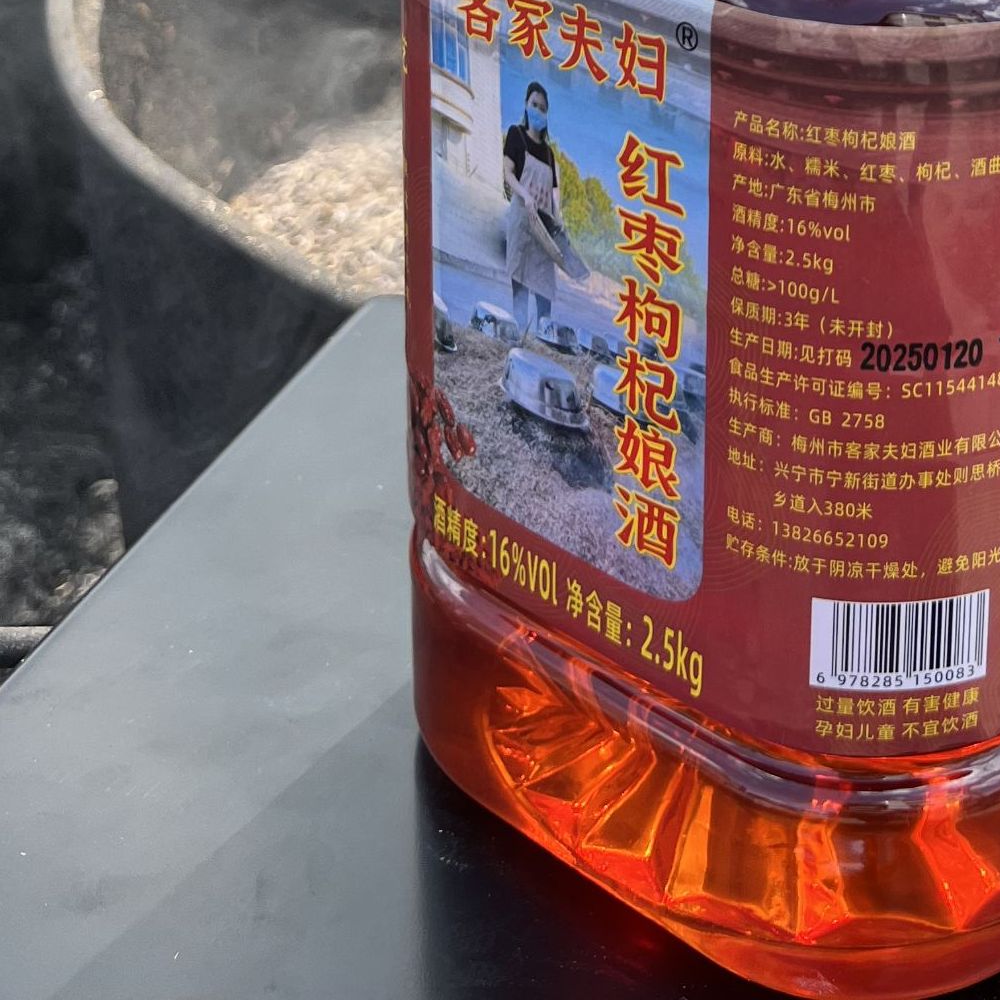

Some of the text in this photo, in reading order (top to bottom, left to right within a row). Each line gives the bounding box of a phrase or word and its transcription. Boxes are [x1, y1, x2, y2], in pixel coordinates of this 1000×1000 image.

[733, 110, 917, 151] 产品名称:红枣枸杞娘酒
[732, 174, 876, 214] 产地:广东省梅州市
[732, 204, 851, 243] 酒精度:16%vol
[731, 235, 835, 276] 净含量:2.5kg
[730, 266, 840, 305] 总糖:>100g/L
[614, 131, 686, 570] 红枣枸杞娘酒
[729, 327, 853, 368] 生产日期:见打码
[859, 338, 984, 373] 20250120
[841, 412, 886, 430] 2758
[772, 491, 874, 521] 乡道入380米
[816, 665, 976, 689] 6 978285 150083
[815, 687, 981, 717] 过量饮酒 有害健康
[815, 711, 979, 742] 孕妇儿童 不宜饮酒
